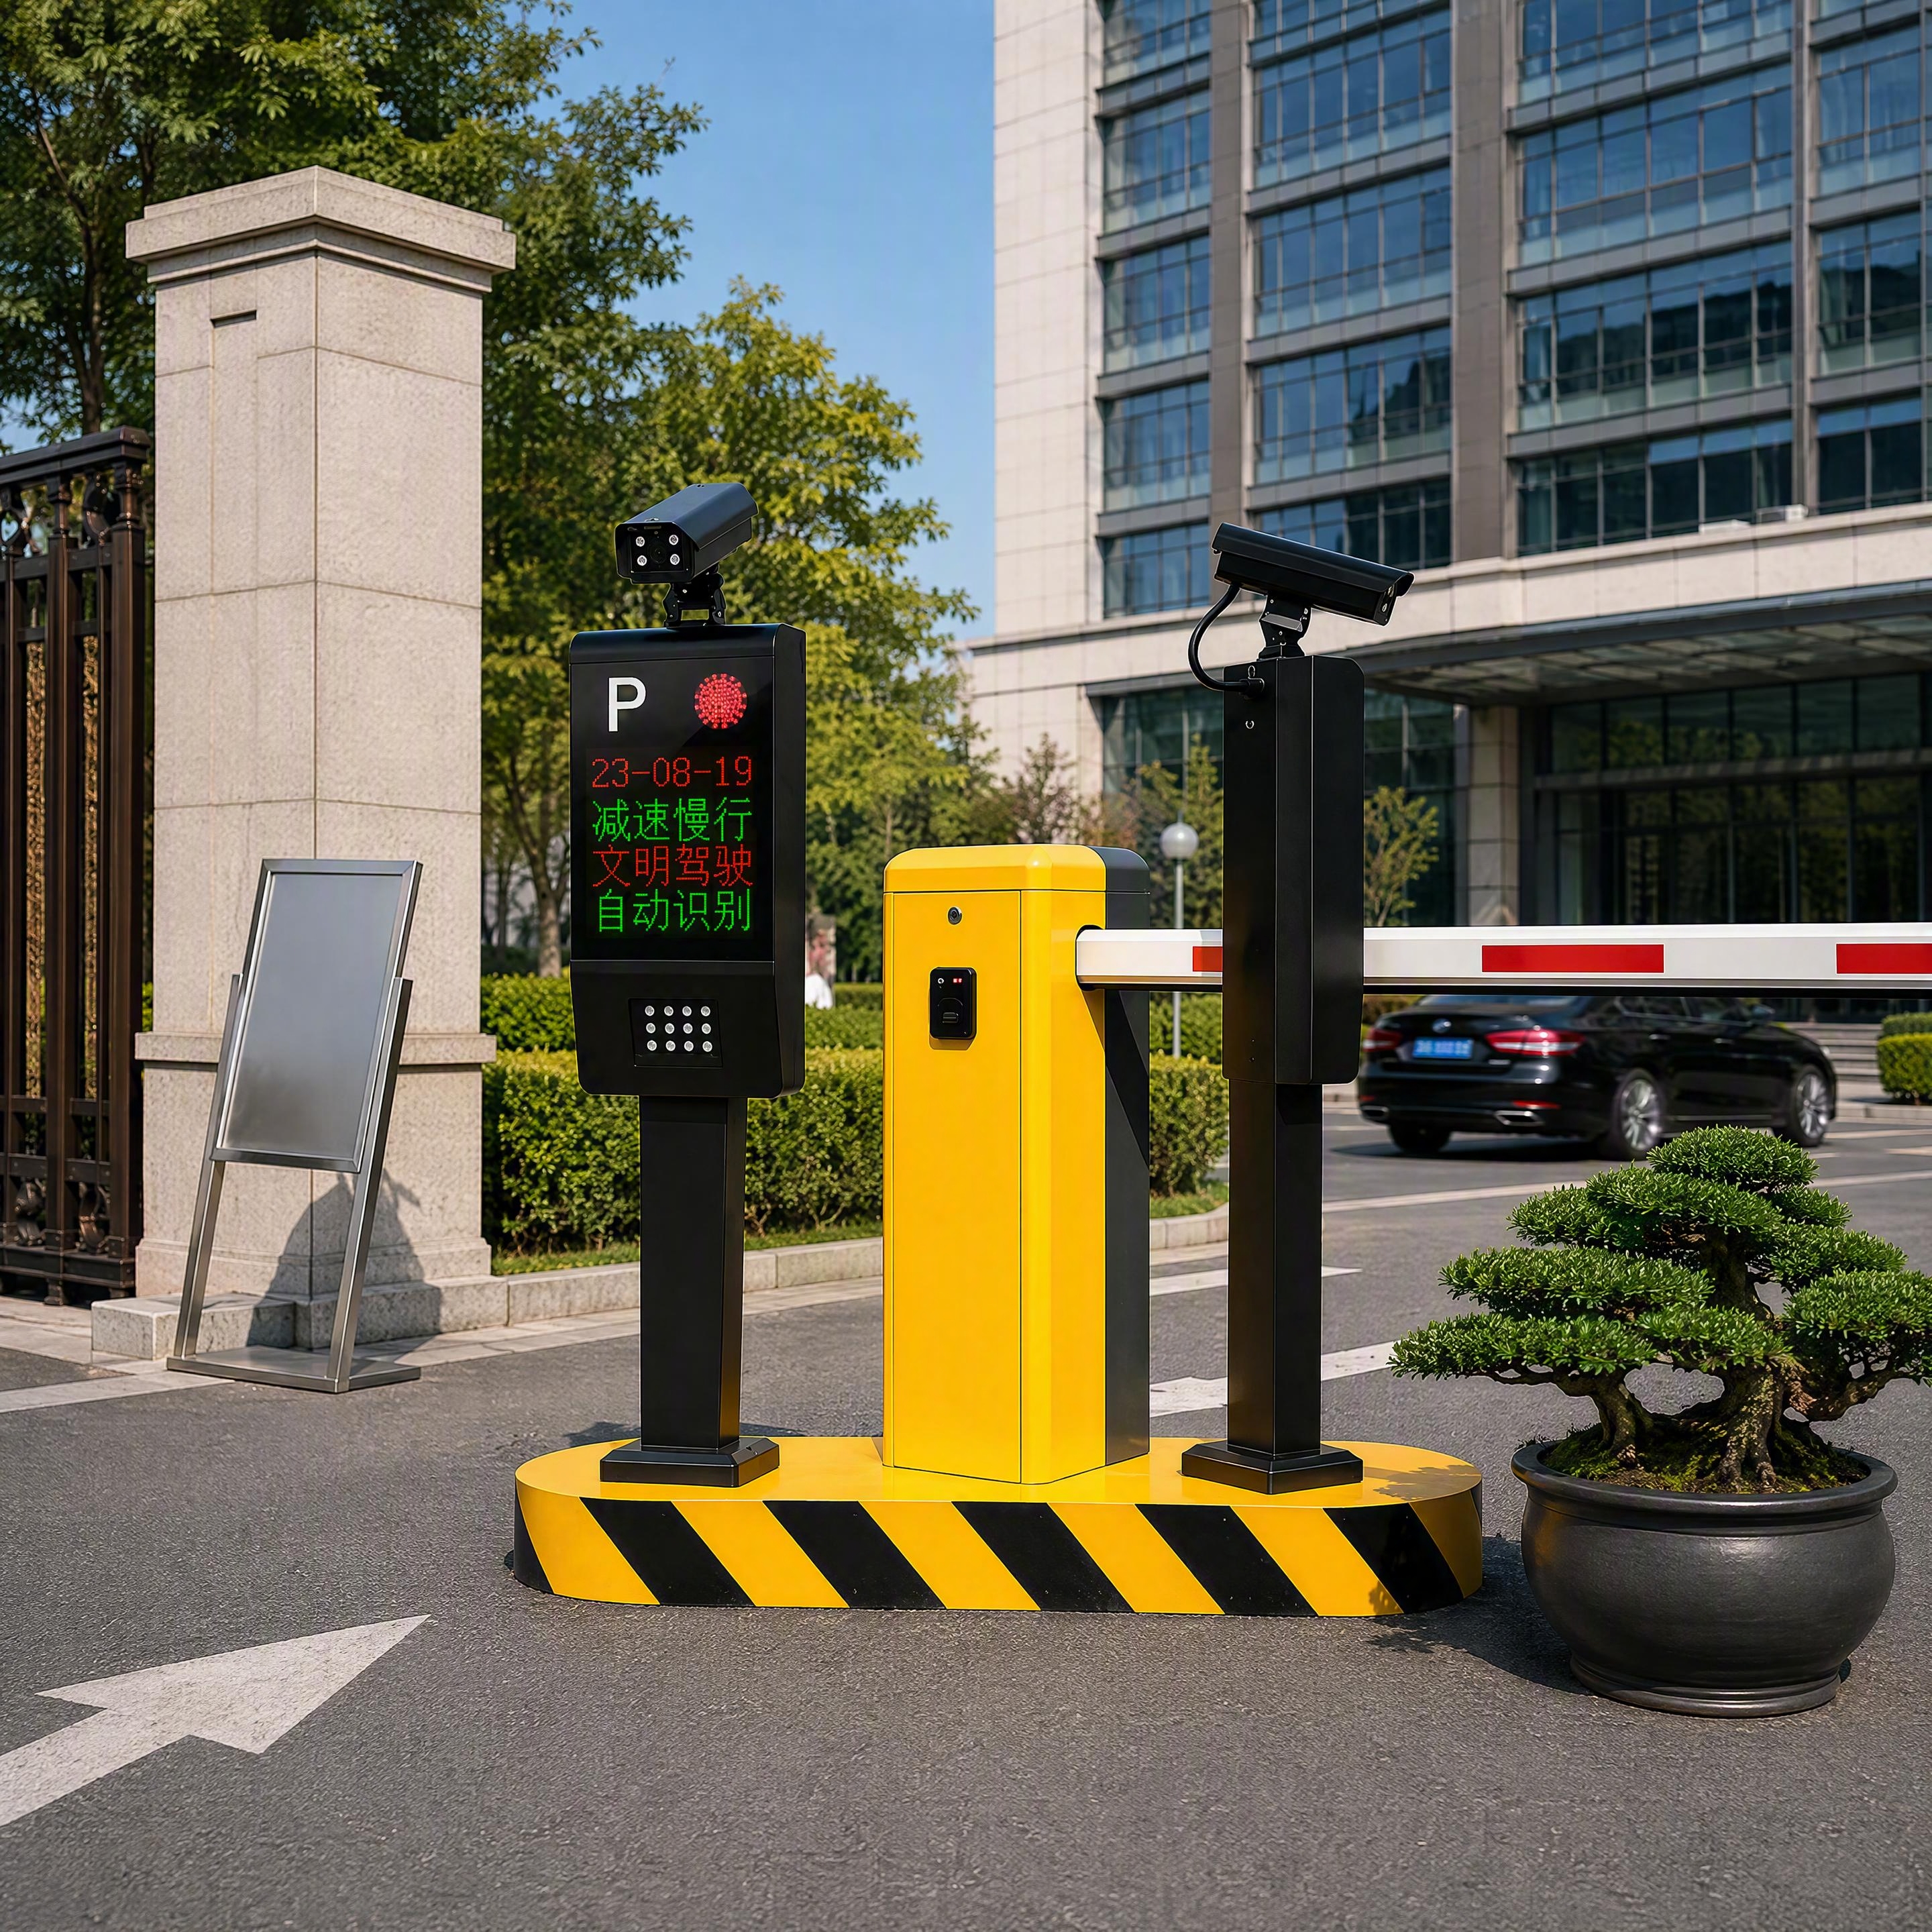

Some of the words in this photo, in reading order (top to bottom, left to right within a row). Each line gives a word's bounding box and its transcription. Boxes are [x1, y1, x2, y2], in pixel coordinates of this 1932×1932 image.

[608, 677, 646, 732] P
[592, 756, 752, 788] 23-08-19
[592, 797, 752, 842] 减速慢行
[592, 843, 753, 887] 文明驾驶
[599, 888, 750, 932] 自动识别
